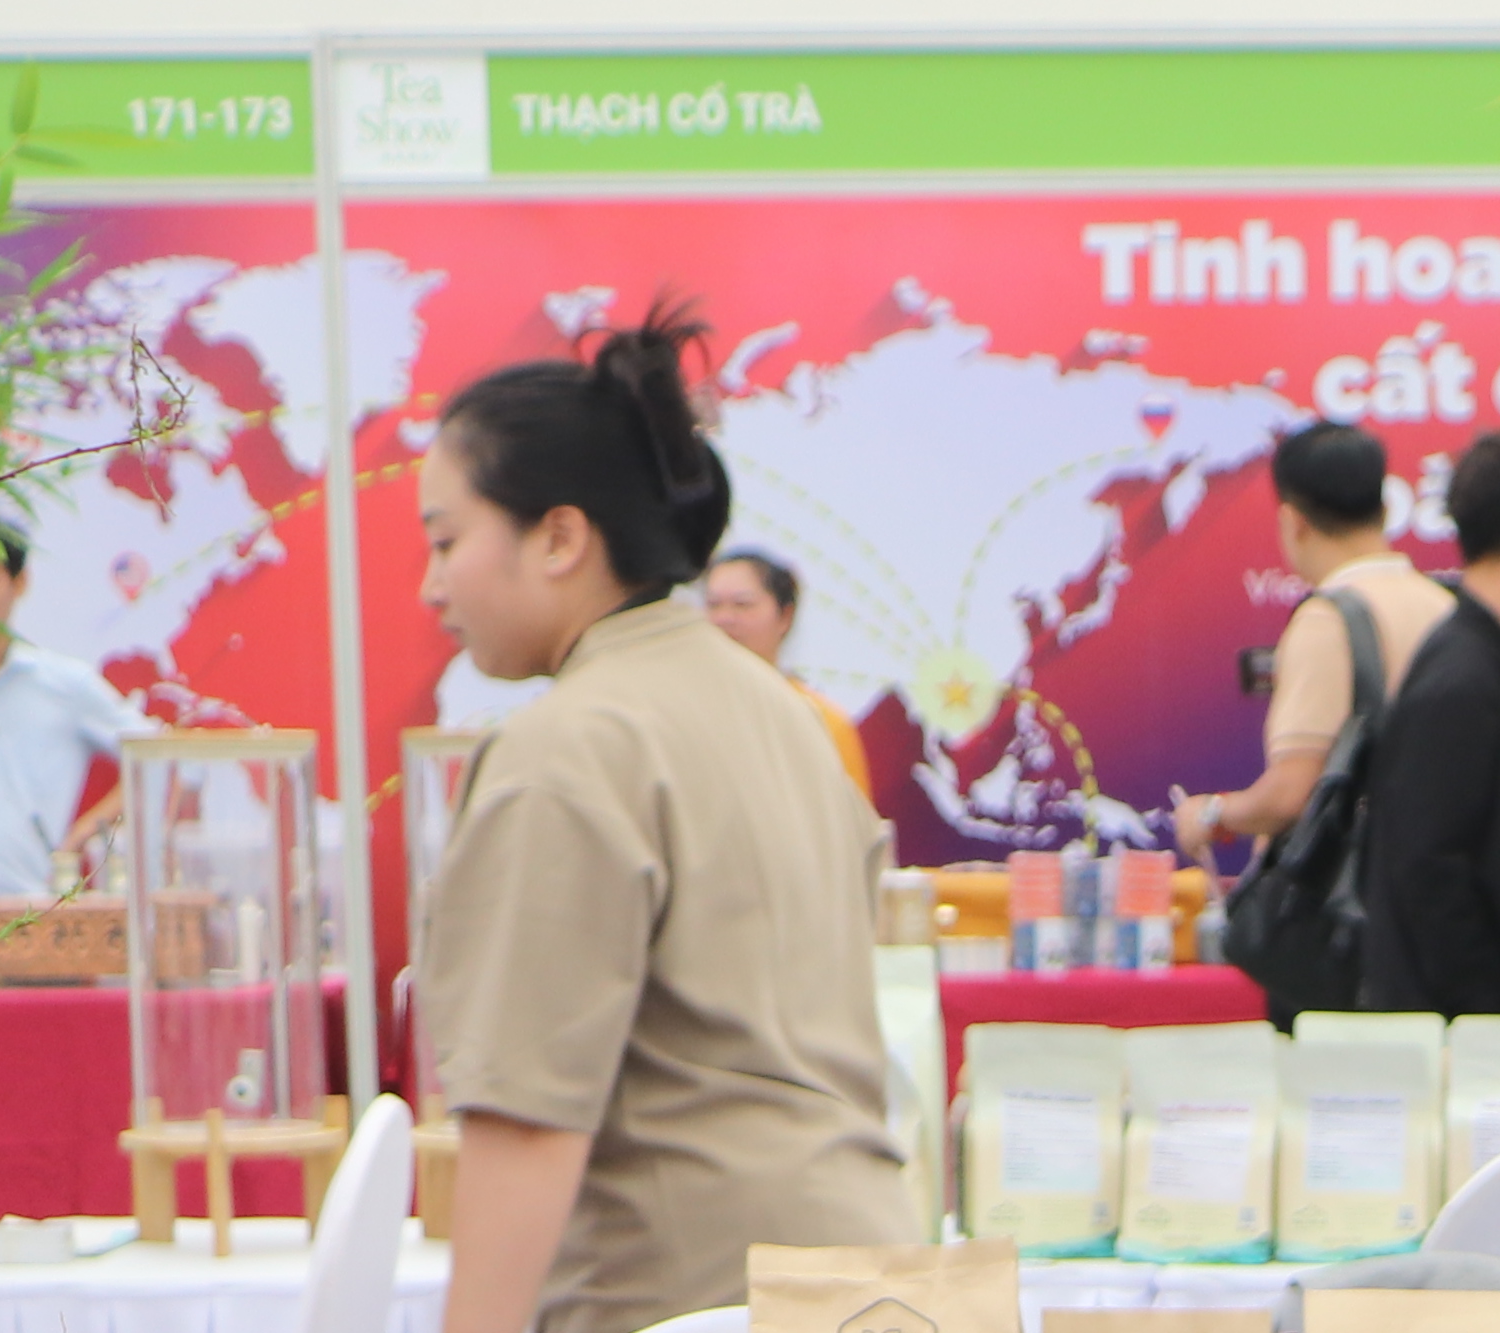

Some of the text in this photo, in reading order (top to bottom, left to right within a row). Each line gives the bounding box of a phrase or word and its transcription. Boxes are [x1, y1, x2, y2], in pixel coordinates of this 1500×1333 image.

[372, 62, 443, 105] Tea
[127, 96, 293, 138] 171-173
[357, 105, 458, 147] Show
[737, 84, 822, 136] TRÀ
[1313, 321, 1477, 422] cất
